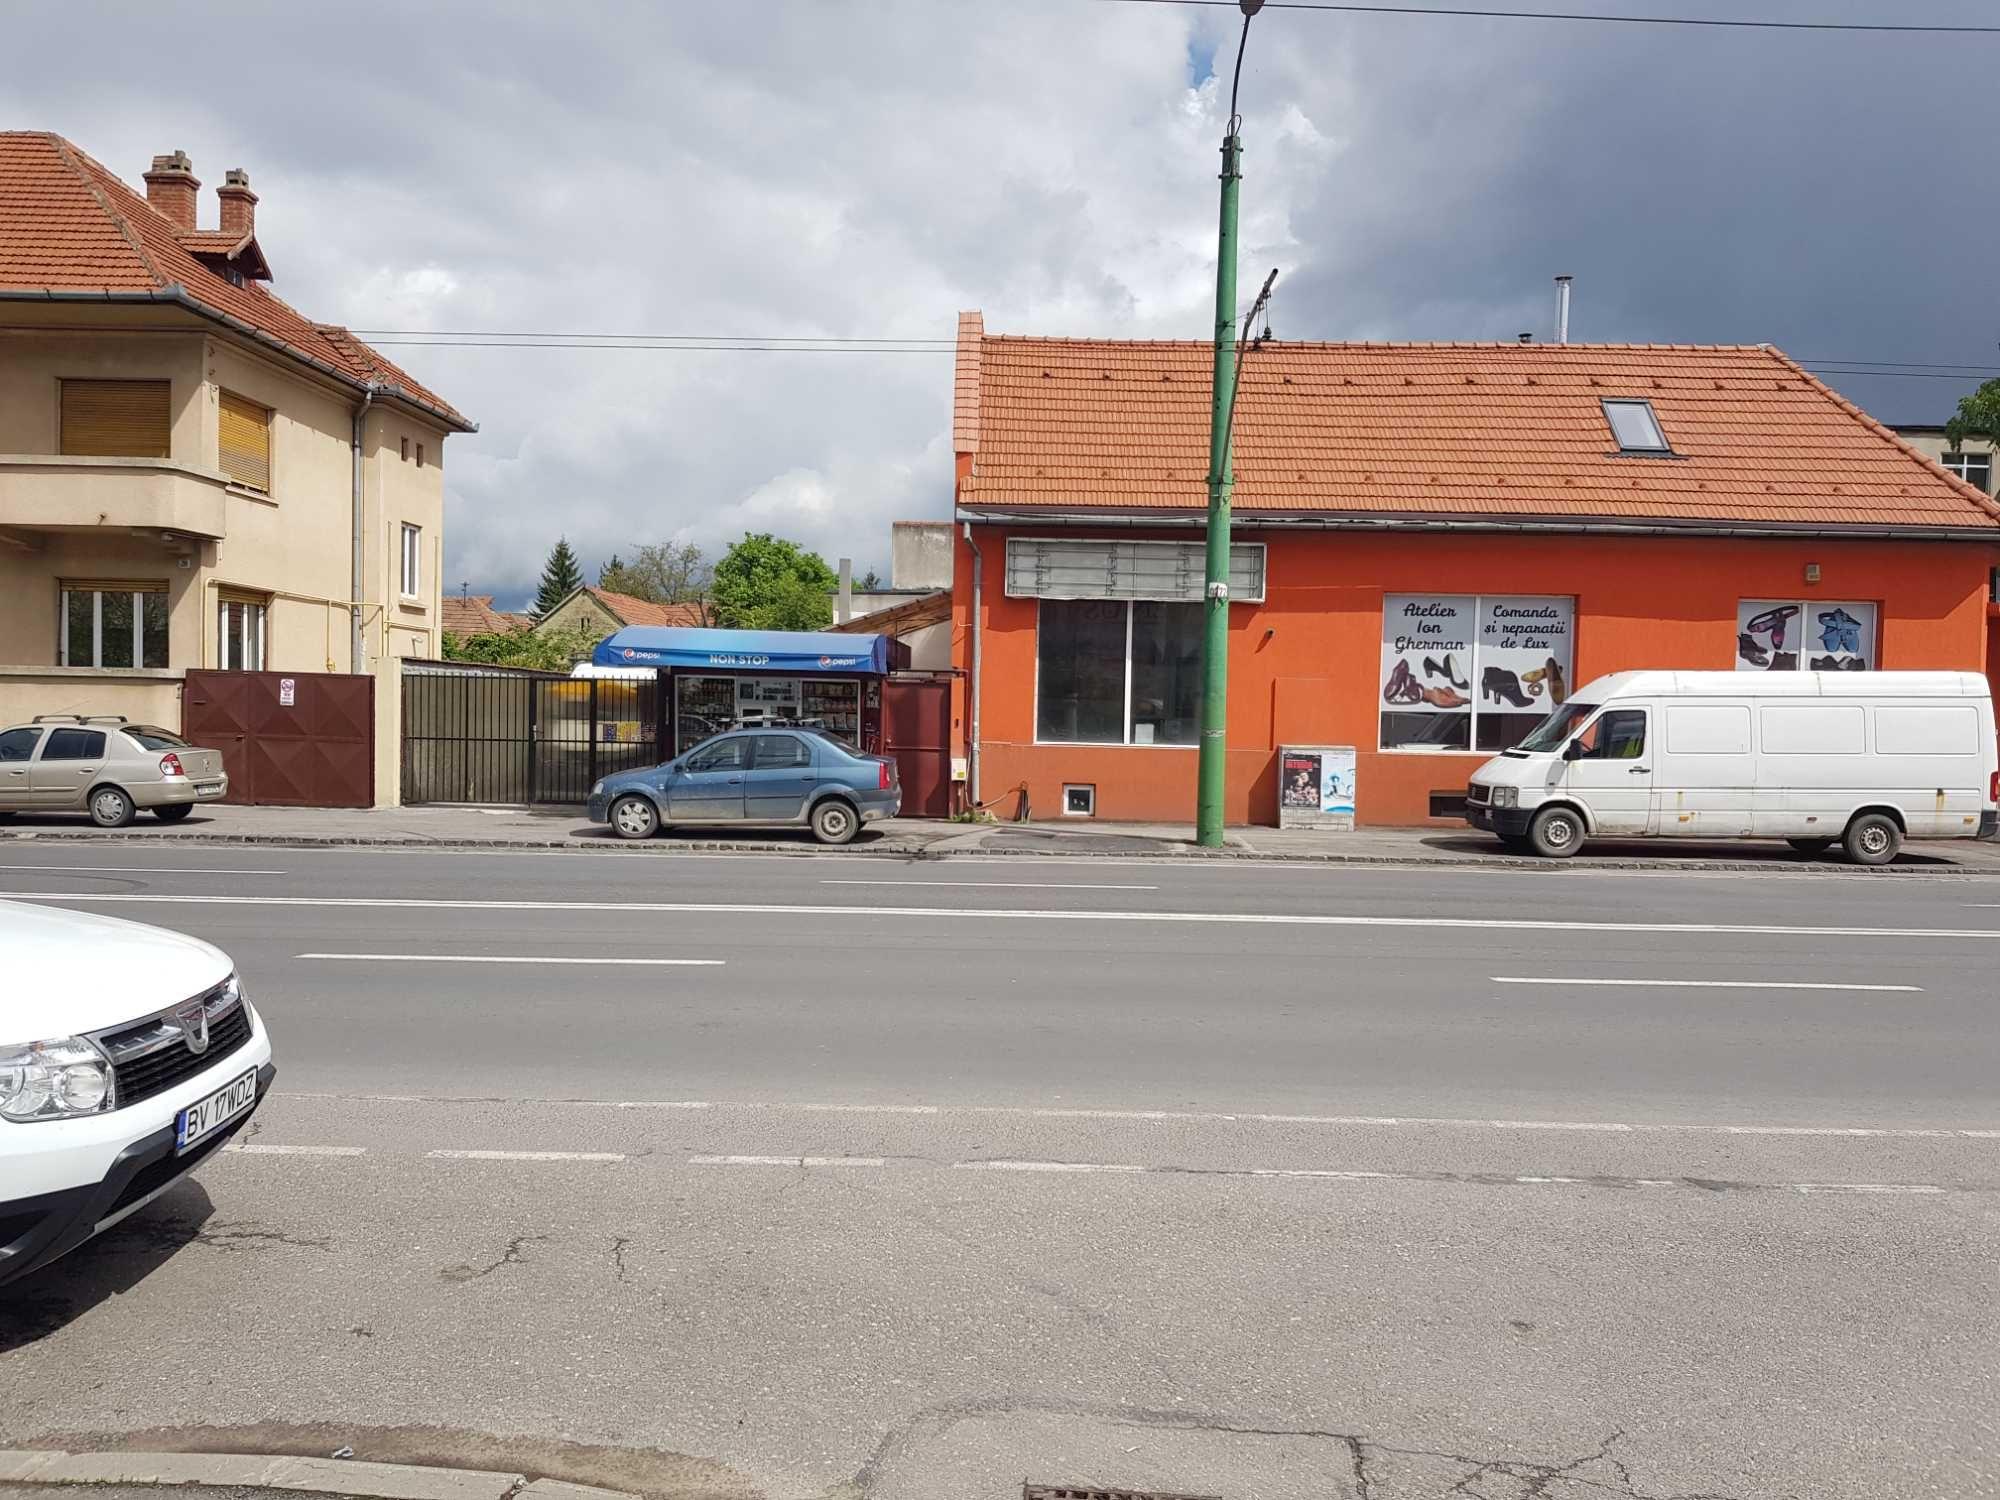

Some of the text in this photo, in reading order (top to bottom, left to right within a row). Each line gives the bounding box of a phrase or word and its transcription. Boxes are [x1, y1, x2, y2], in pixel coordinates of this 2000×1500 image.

[1403, 603, 1457, 617] Atelier
[1493, 604, 1559, 618] Comanda
[1417, 620, 1442, 633] Ion
[1395, 636, 1465, 654] Gherman
[1500, 637, 1549, 649] de Lux
[710, 654, 770, 666] NON STOP
[187, 1073, 254, 1138] BV 17WDZ
